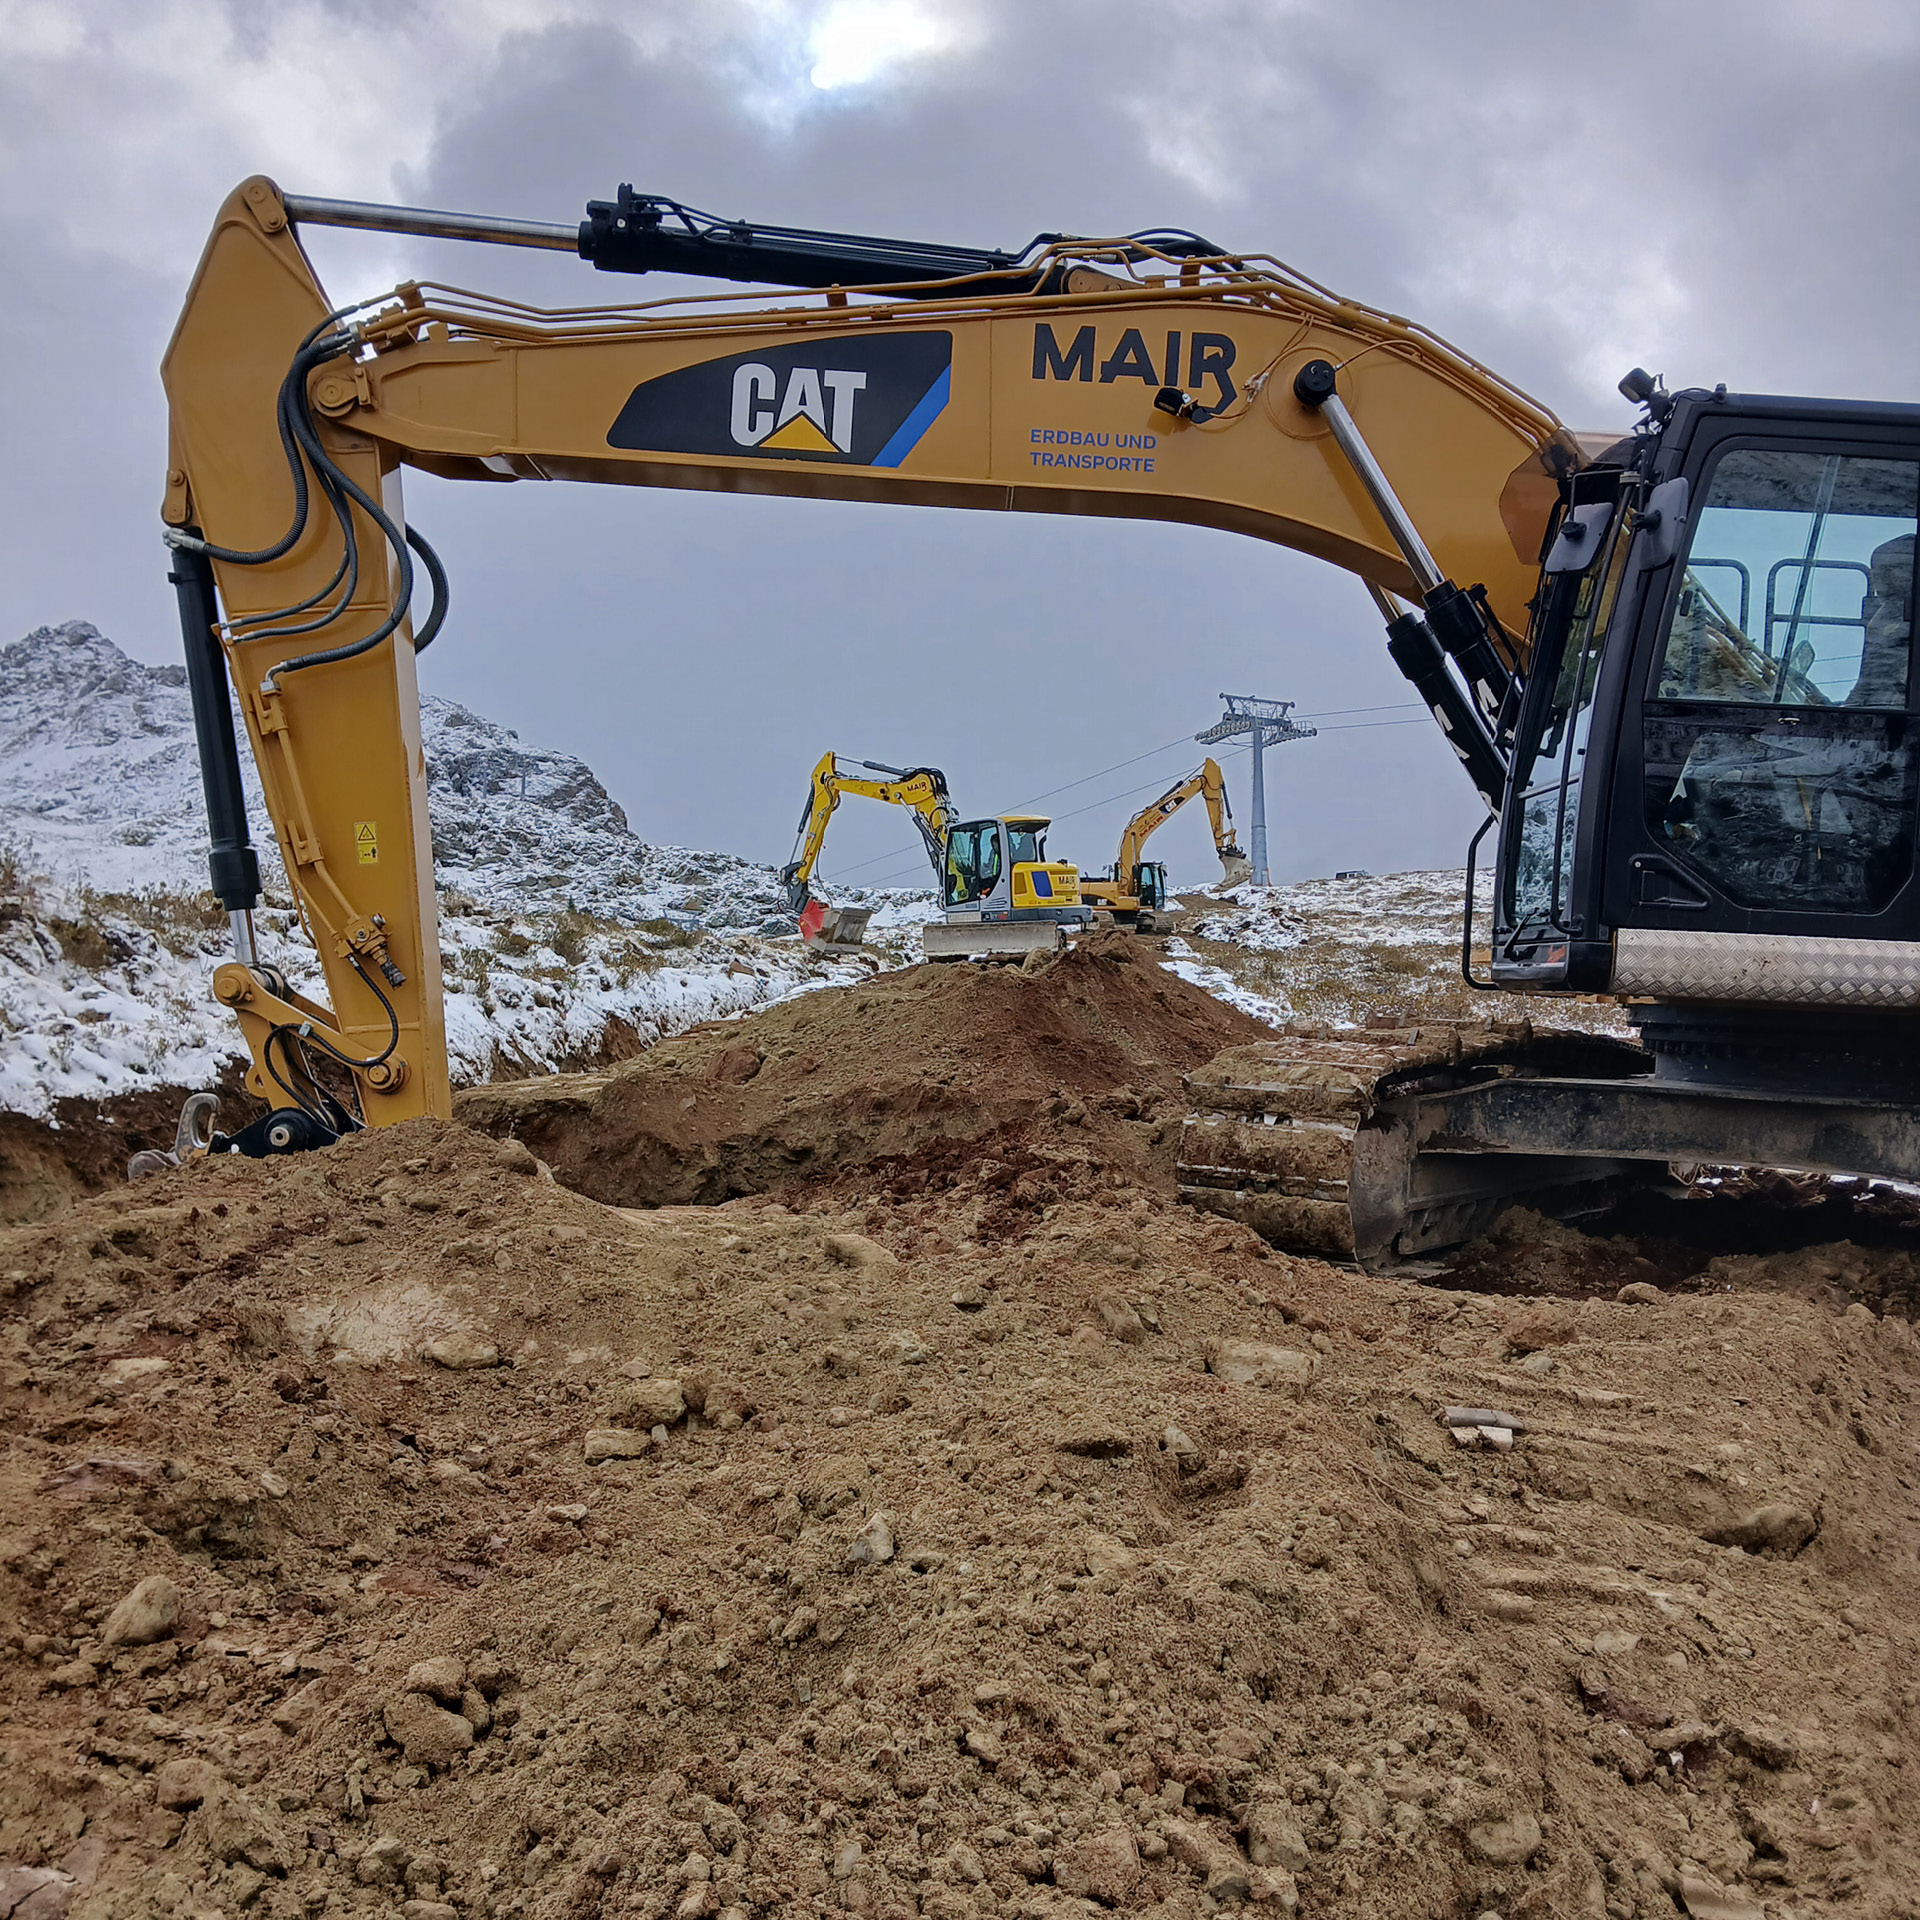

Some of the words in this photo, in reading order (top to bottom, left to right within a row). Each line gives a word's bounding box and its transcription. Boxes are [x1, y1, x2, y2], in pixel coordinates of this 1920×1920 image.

[1032, 323, 1238, 424] MAIR
[730, 363, 867, 453] CAT
[1030, 429, 1110, 447] ERDBAU
[1115, 433, 1157, 449] UND
[1030, 452, 1155, 472] TRANSPORTE
[906, 782, 927, 792] MAIR
